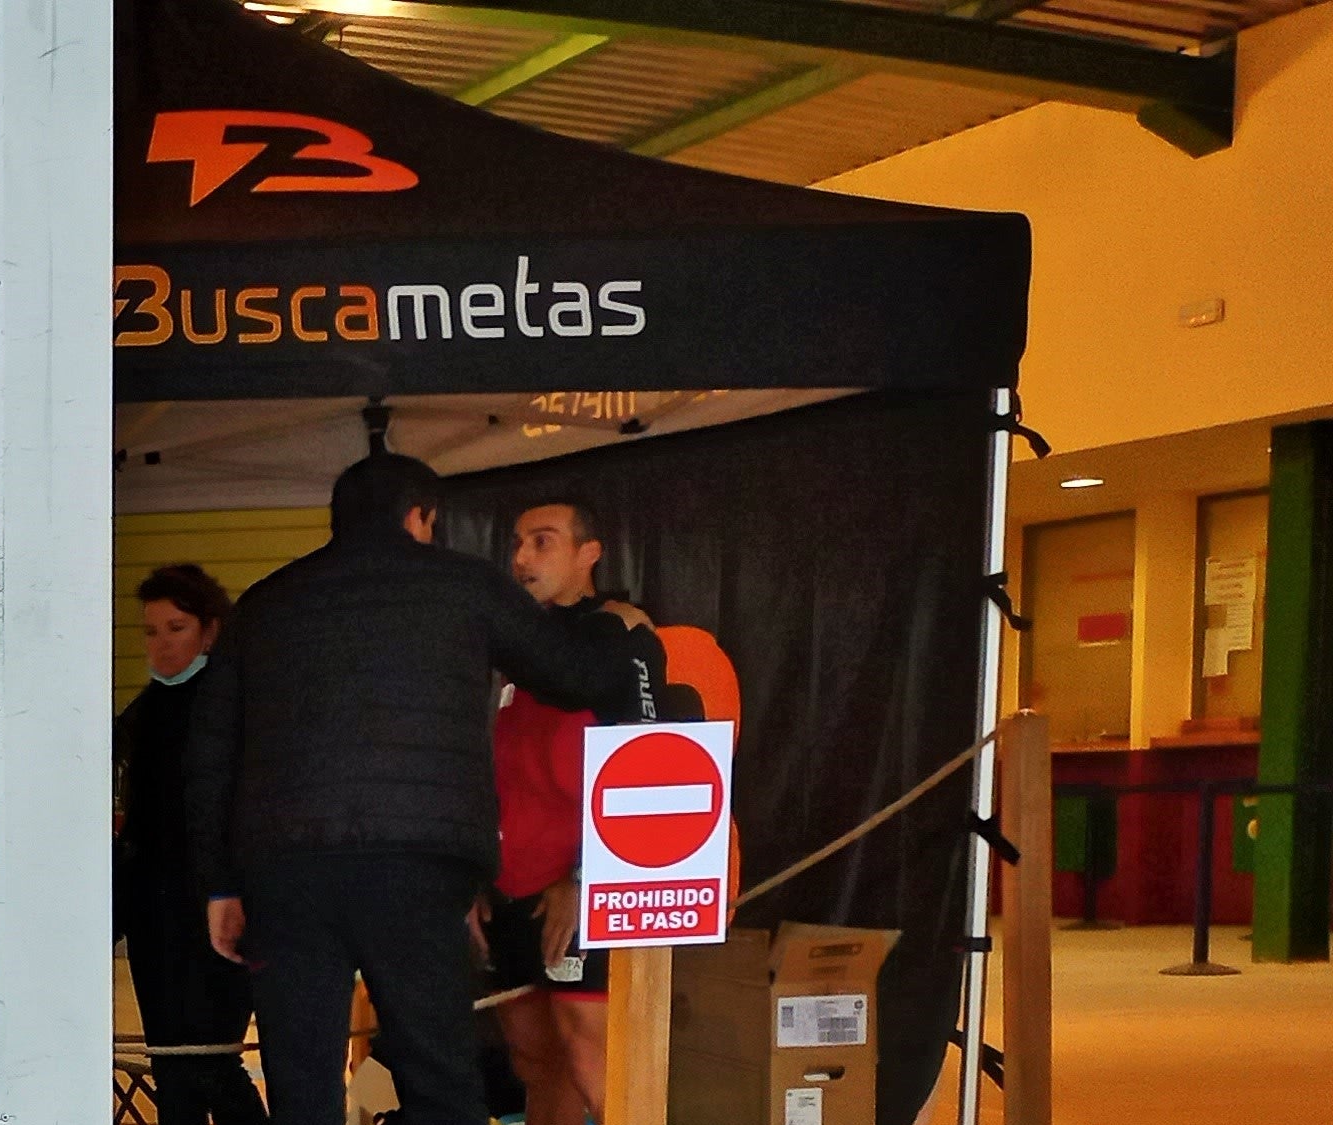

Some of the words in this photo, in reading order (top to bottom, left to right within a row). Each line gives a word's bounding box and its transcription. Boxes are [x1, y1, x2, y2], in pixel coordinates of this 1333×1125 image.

[113, 256, 646, 347] Buscametas
[593, 887, 715, 911] PROHIBIDO
[607, 913, 635, 932] EL
[641, 910, 699, 930] PASO
